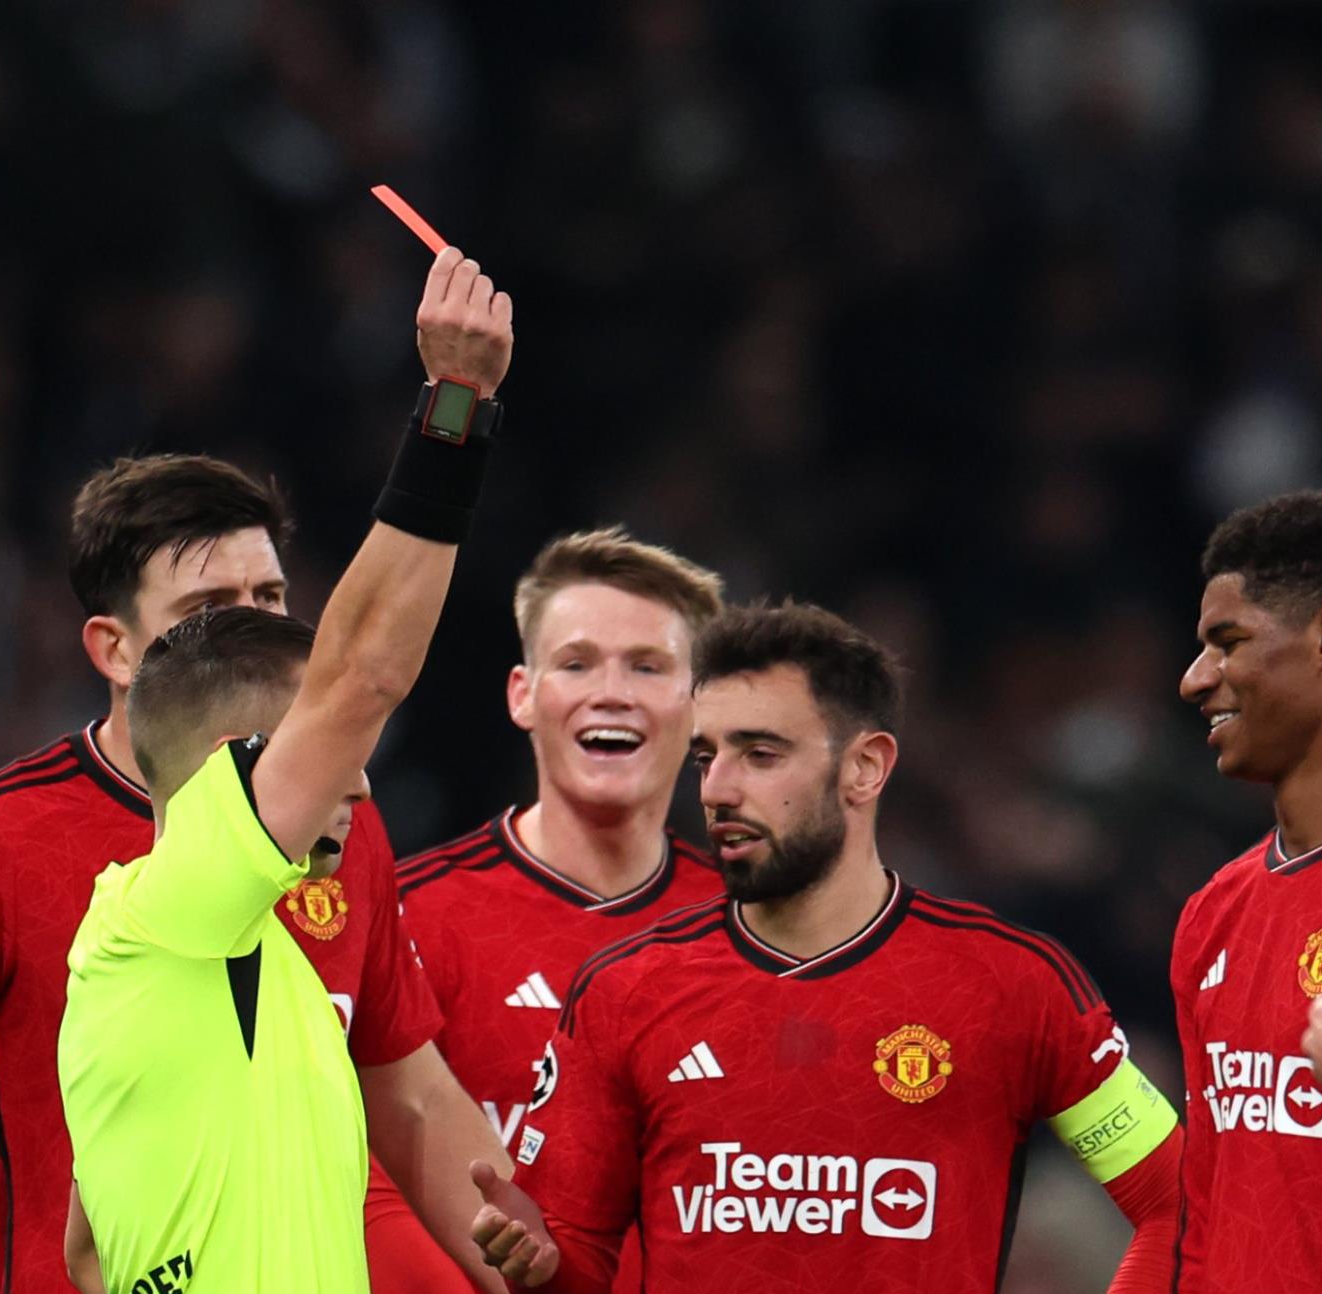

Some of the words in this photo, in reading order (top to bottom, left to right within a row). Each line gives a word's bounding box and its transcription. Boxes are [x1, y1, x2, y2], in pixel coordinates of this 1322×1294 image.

[891, 1083, 936, 1098] UNITED
[701, 1142, 858, 1191] Team
[672, 1184, 856, 1234] Viewer
